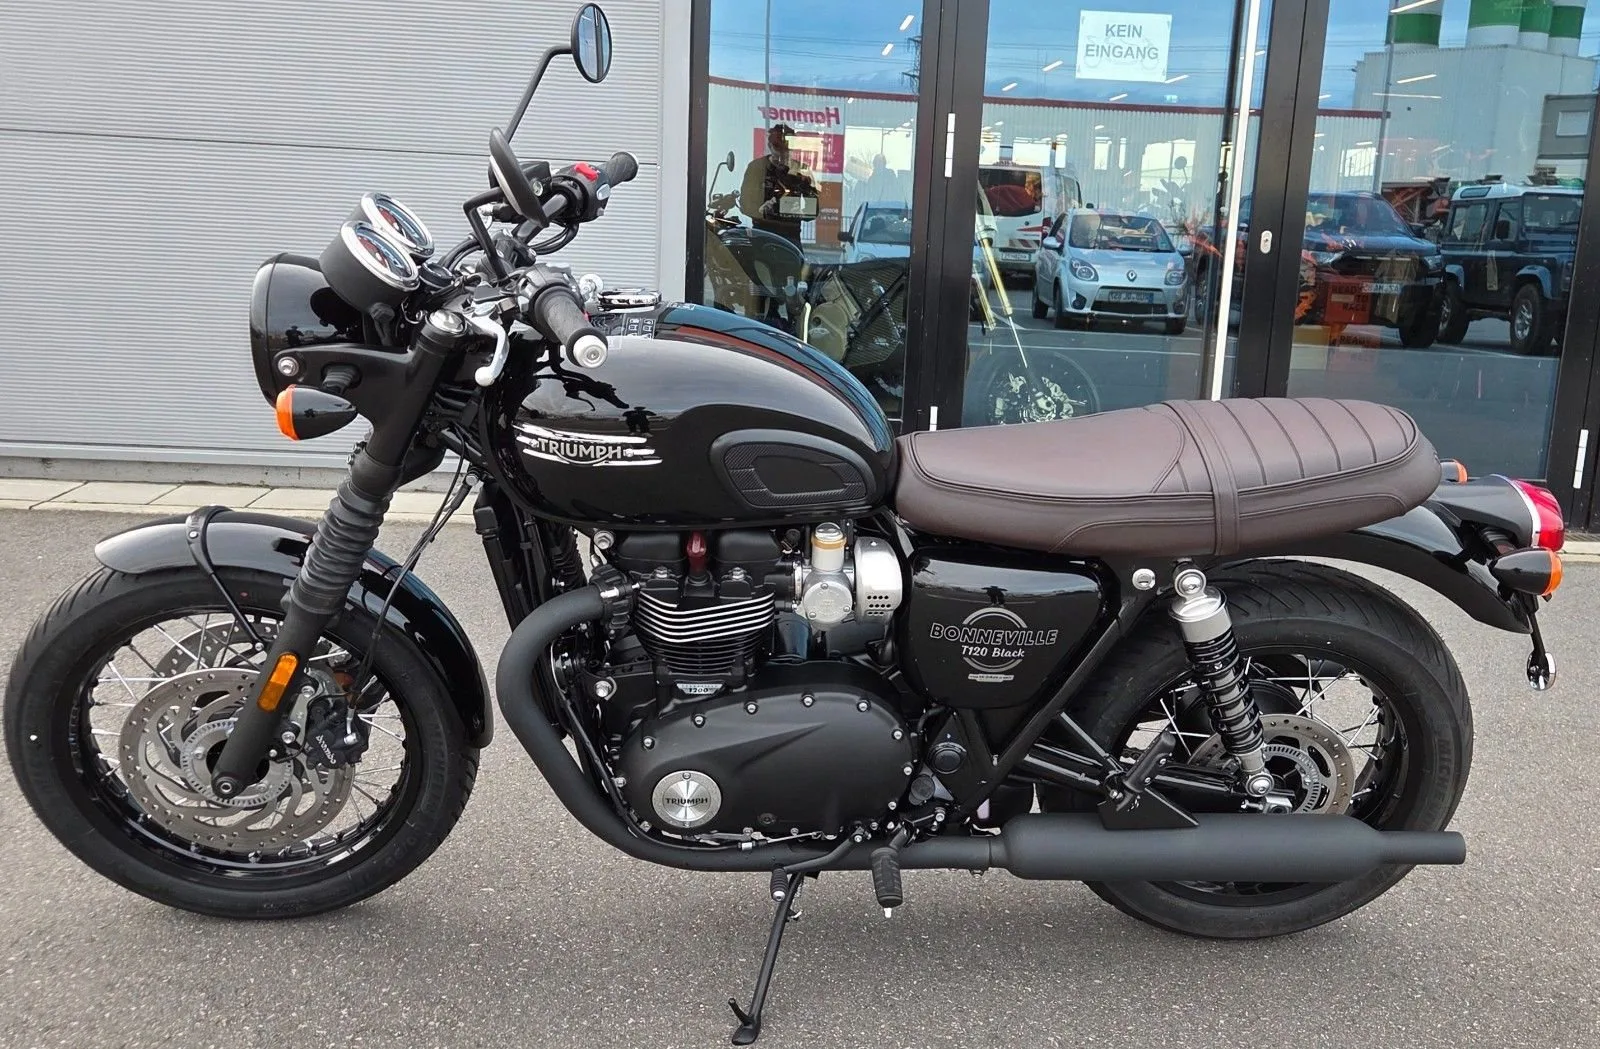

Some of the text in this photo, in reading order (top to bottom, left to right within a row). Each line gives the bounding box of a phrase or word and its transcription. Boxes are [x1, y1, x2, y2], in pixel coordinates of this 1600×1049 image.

[1105, 23, 1143, 38] KEIN
[1085, 43, 1159, 60] EINGANG
[537, 437, 622, 461] TRIUMPH
[929, 622, 1059, 646] BONNEVILLE
[961, 645, 1025, 658] T120 Black
[665, 797, 708, 806] TRIUMPH
